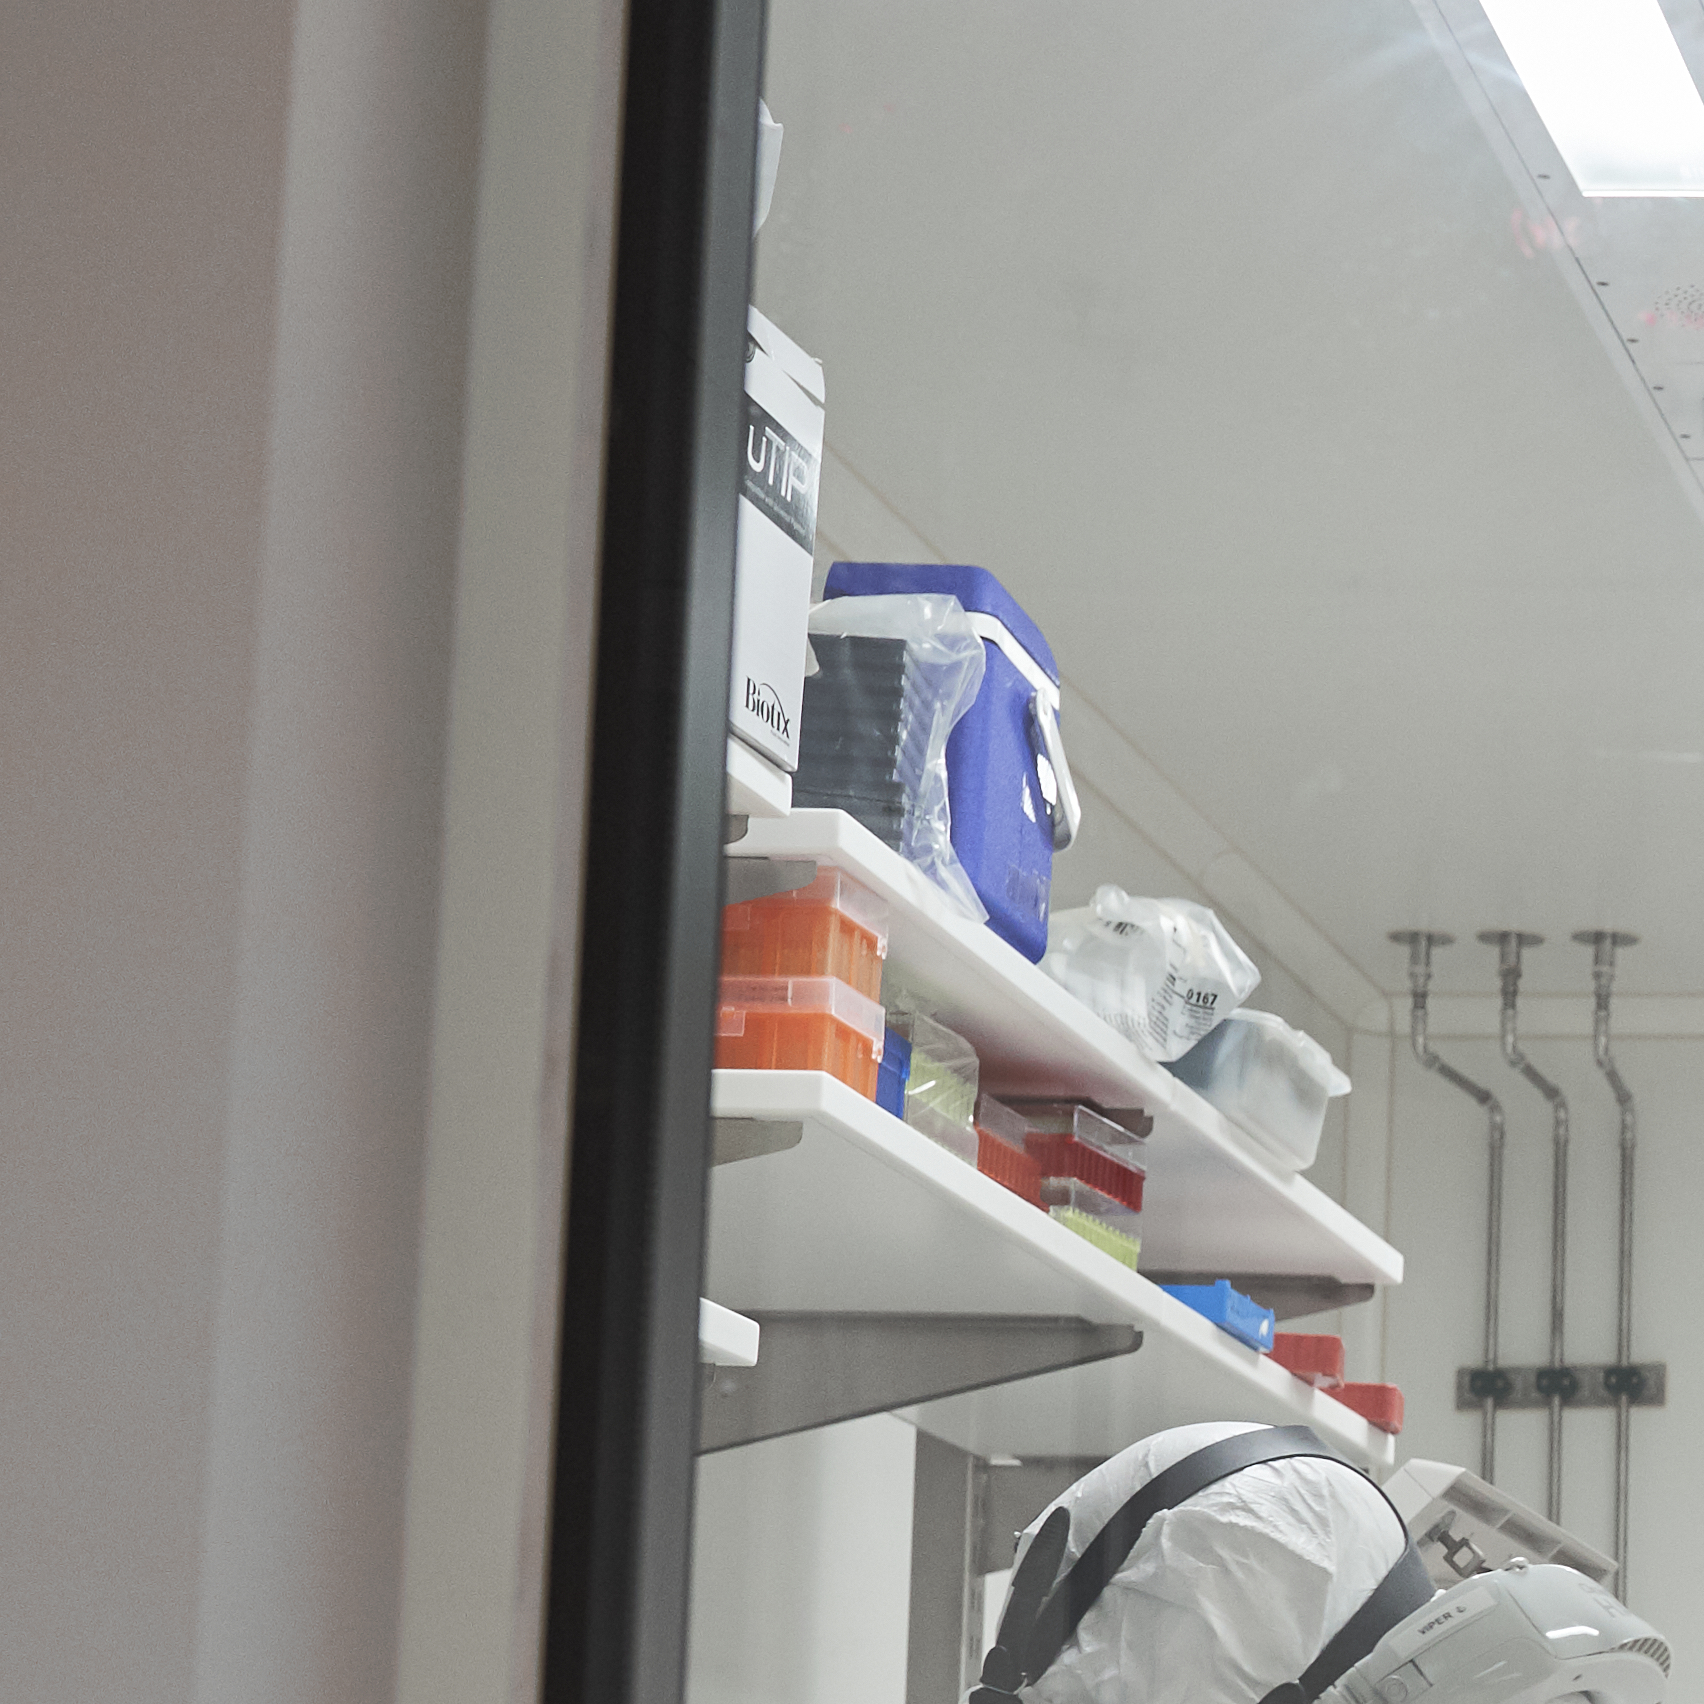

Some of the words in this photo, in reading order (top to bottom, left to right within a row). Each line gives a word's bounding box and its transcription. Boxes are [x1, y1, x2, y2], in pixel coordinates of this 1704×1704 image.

[744, 675, 790, 740] Biotix
[1186, 988, 1218, 1007] 0167
[1417, 1611, 1454, 1636] VIPER
